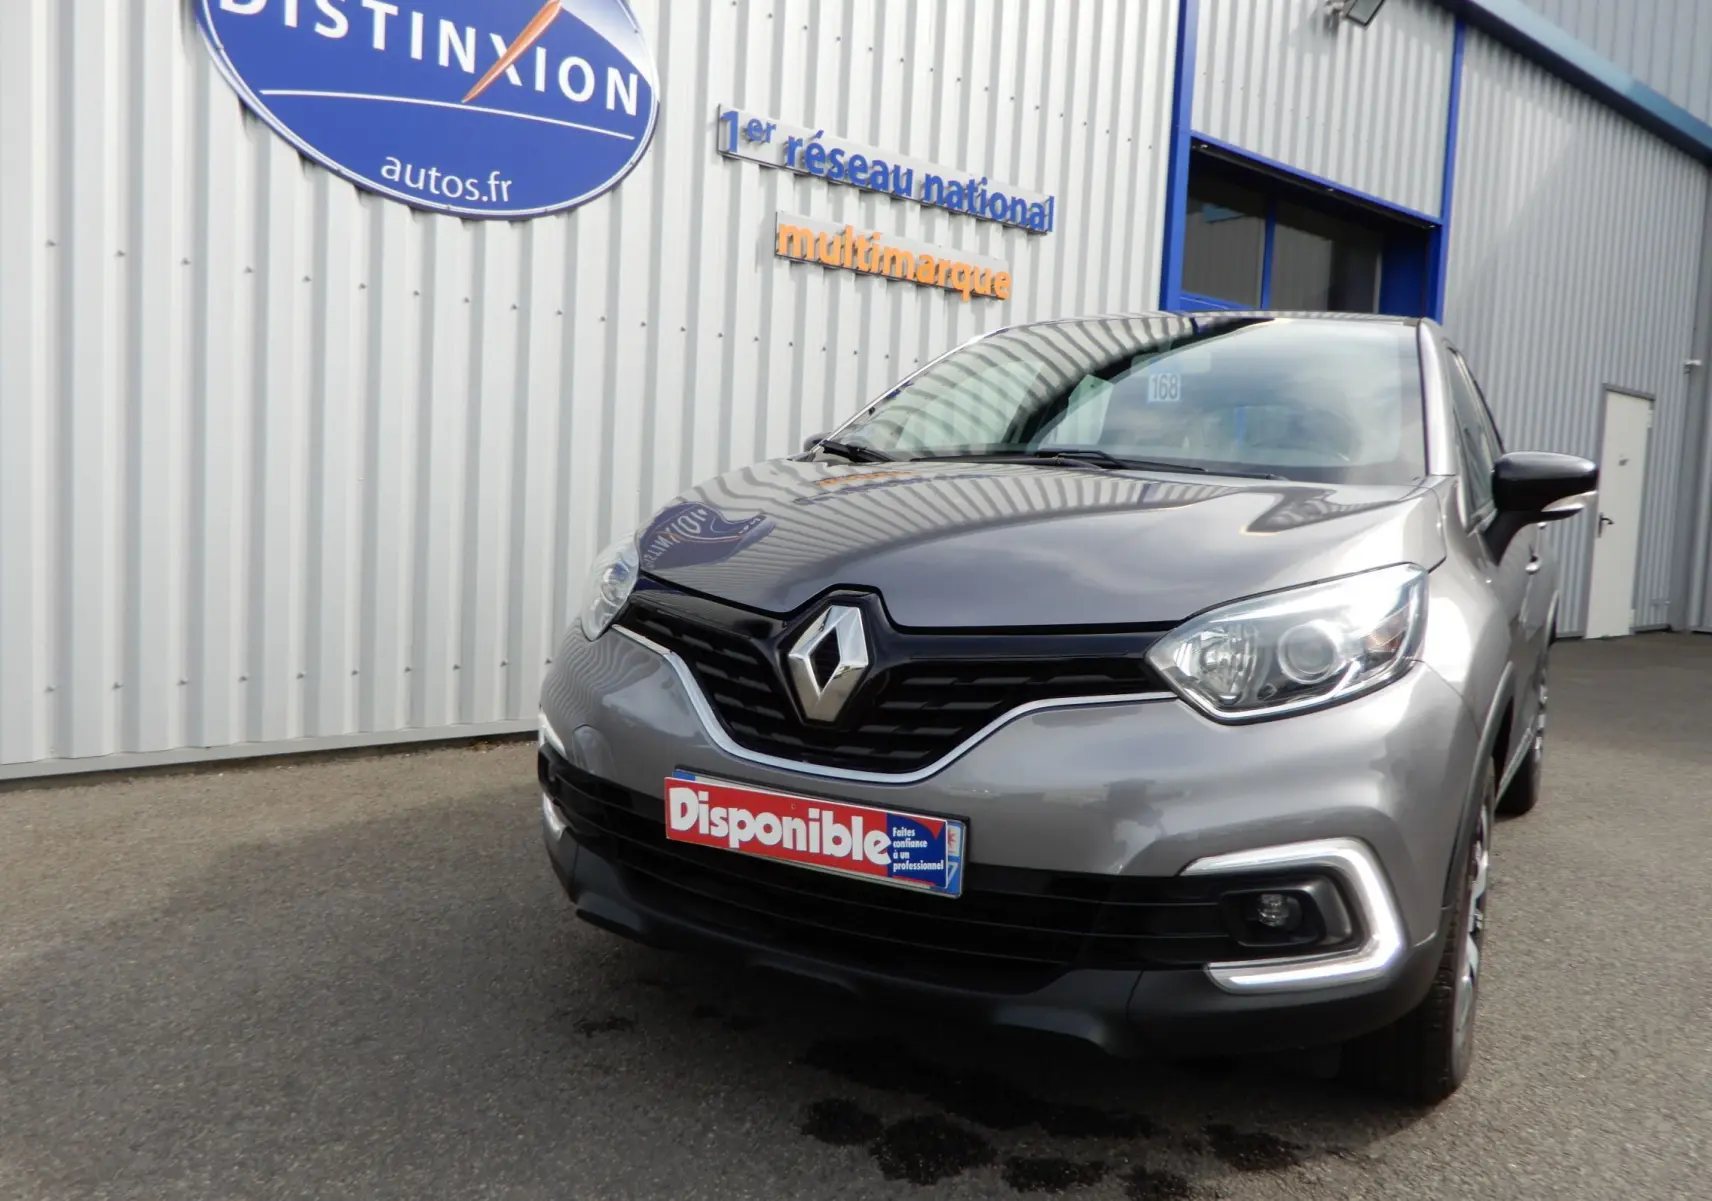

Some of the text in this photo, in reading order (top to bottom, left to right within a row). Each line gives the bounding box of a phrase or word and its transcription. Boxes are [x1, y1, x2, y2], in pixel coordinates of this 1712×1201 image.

[380, 155, 513, 203] autos.fr
[720, 109, 1055, 233] 1er réseau national
[776, 224, 1013, 302] multimarque
[1151, 373, 1179, 400] 168
[668, 786, 893, 866] Disponible
[892, 826, 916, 837] Faites
[892, 837, 928, 848] confiance
[899, 851, 911, 859] un
[892, 859, 944, 873] professionnel
